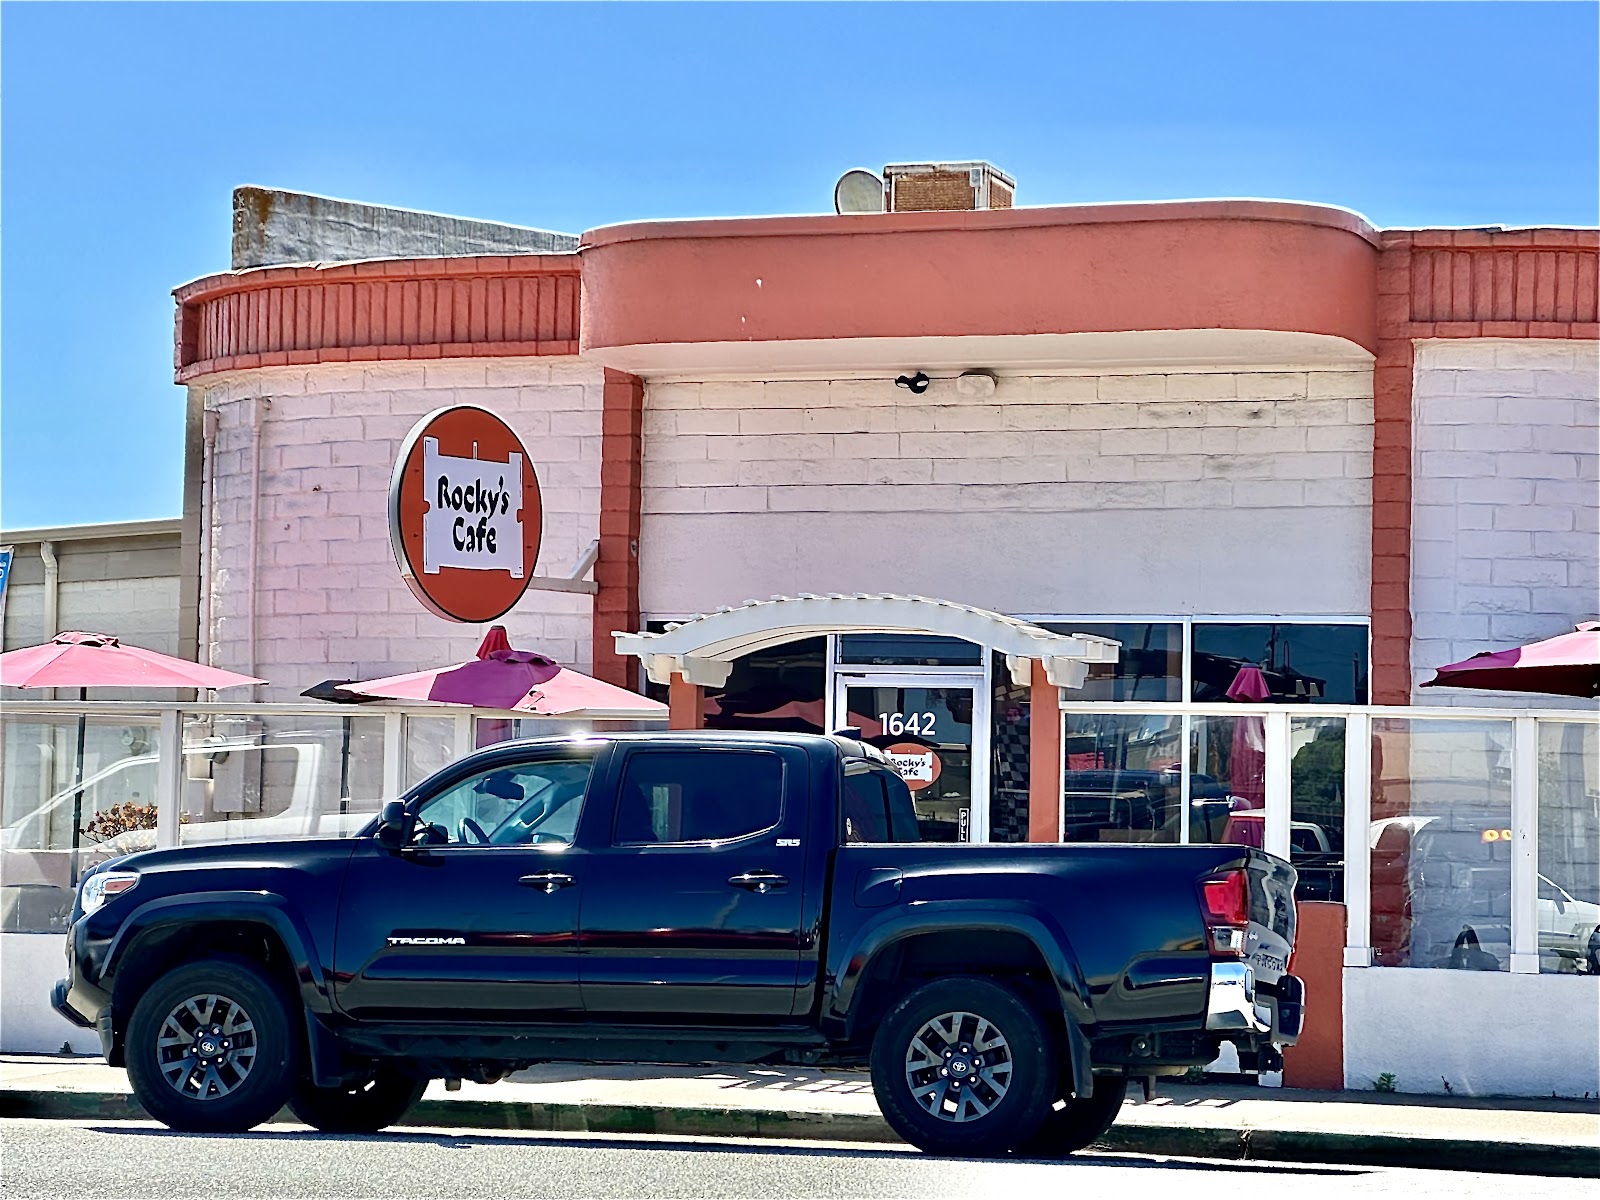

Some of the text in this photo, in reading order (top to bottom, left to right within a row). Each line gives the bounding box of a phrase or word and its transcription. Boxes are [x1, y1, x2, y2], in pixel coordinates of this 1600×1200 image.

[437, 475, 510, 519] Rocky's
[452, 516, 497, 554] Cafe
[878, 711, 936, 736] 1642
[775, 838, 801, 847] SR5
[387, 937, 466, 945] TACOMA
